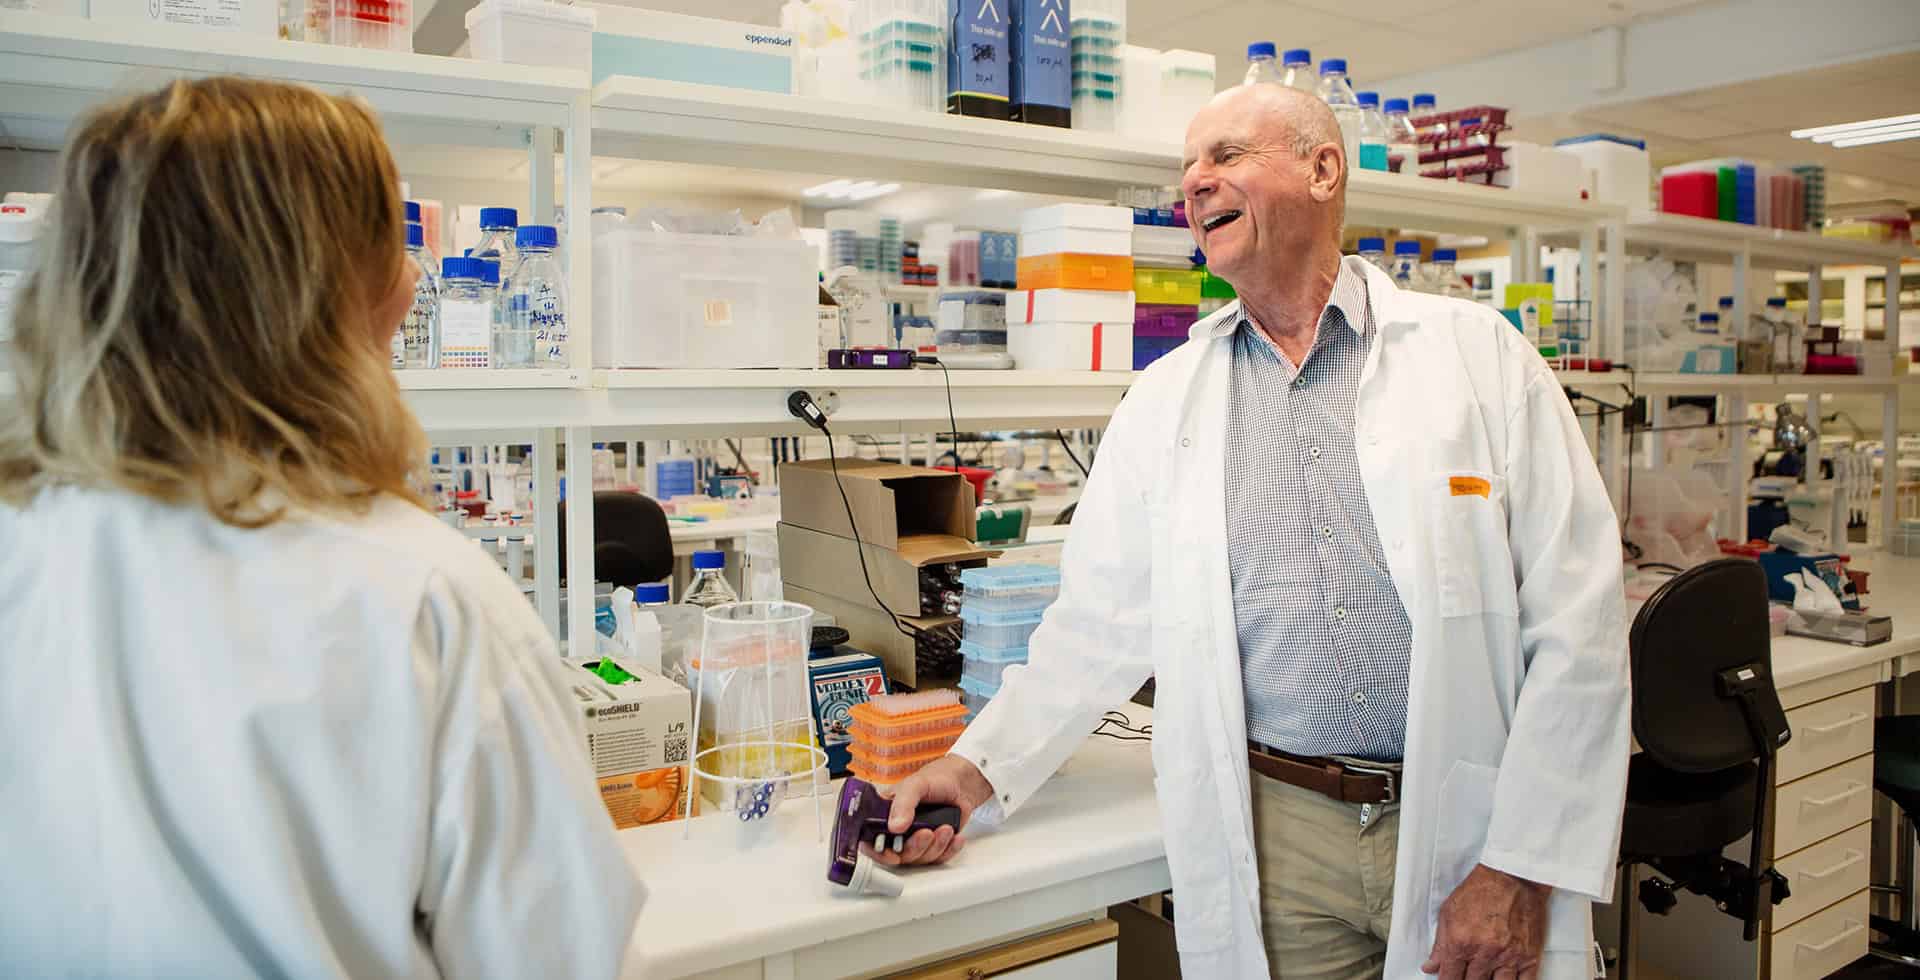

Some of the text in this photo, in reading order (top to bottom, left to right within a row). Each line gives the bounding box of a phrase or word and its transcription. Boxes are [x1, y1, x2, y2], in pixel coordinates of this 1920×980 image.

[744, 34, 792, 46] eppendorf
[816, 675, 886, 696] VORTEX 2
